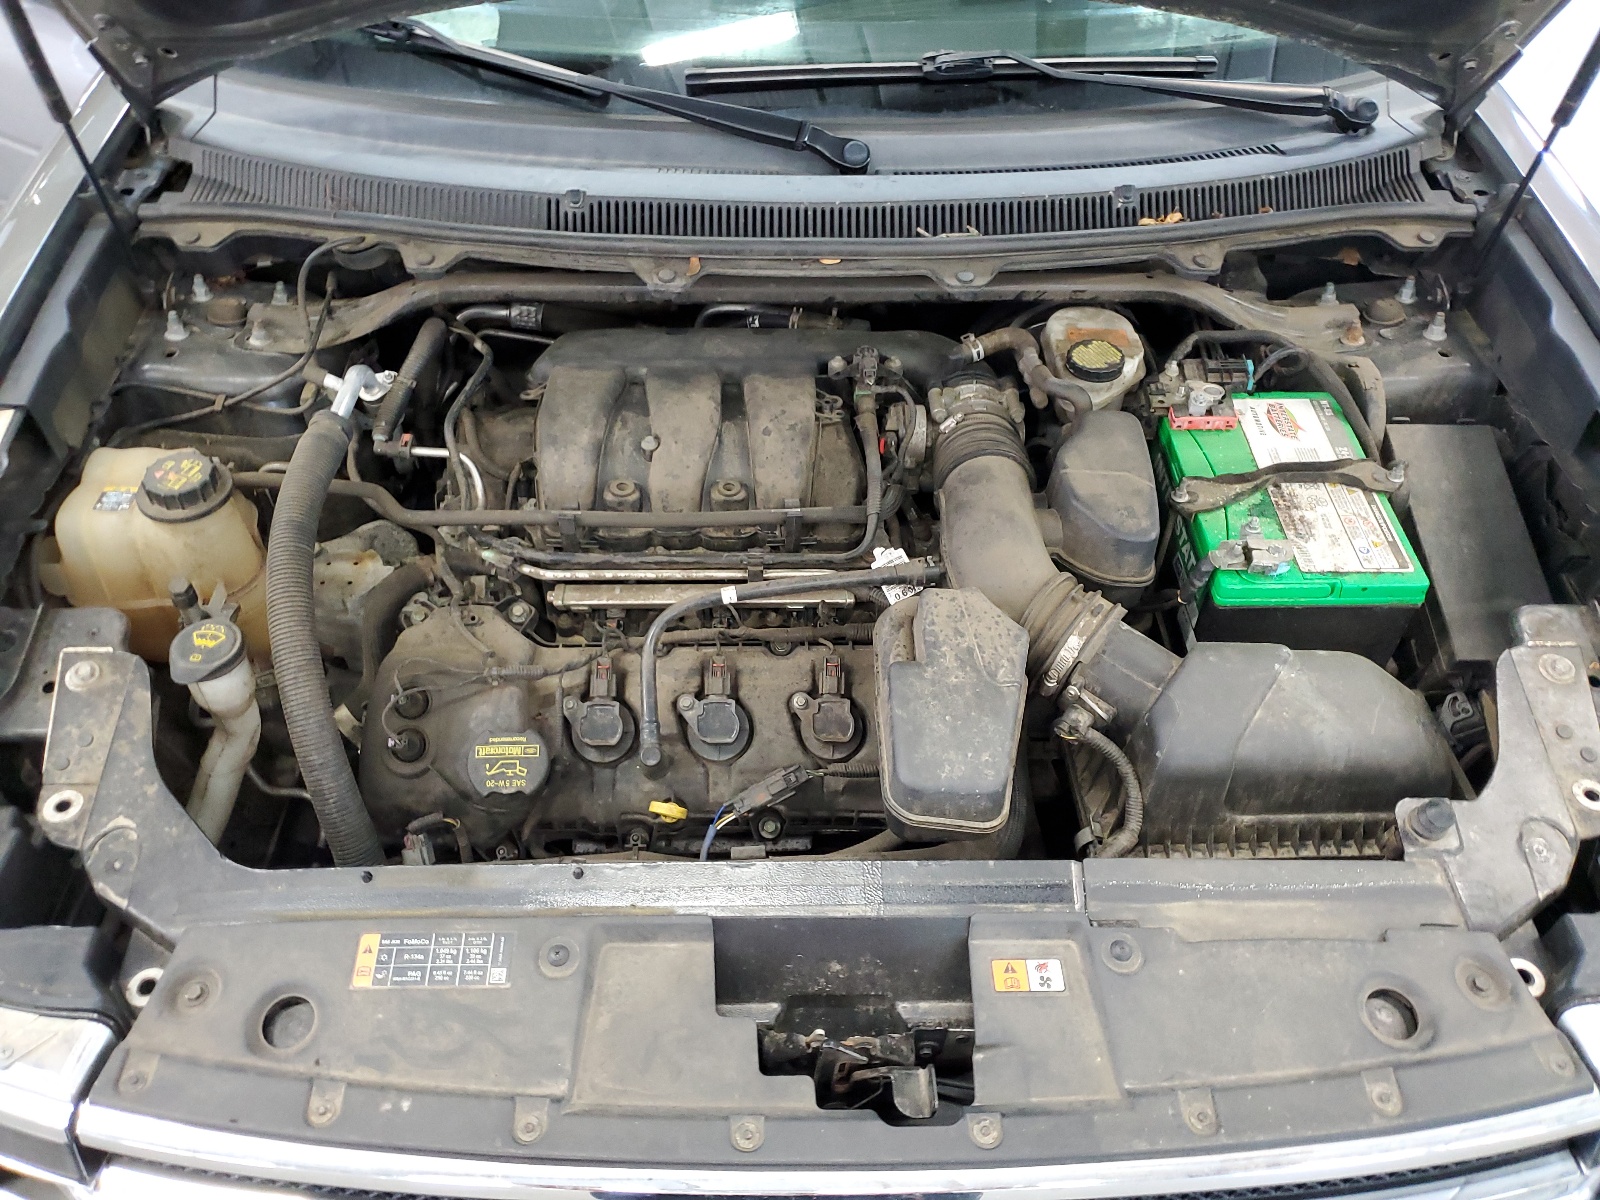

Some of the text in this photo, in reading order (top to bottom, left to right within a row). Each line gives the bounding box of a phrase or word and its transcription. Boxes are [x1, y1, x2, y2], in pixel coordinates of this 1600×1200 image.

[1249, 406, 1267, 436] AUTOMOTIVE
[1267, 403, 1289, 437] BATTERIES
[1276, 402, 1299, 439] INTERSTATE
[478, 746, 522, 756] Motorcraft
[485, 779, 527, 787] SAE 5W-20
